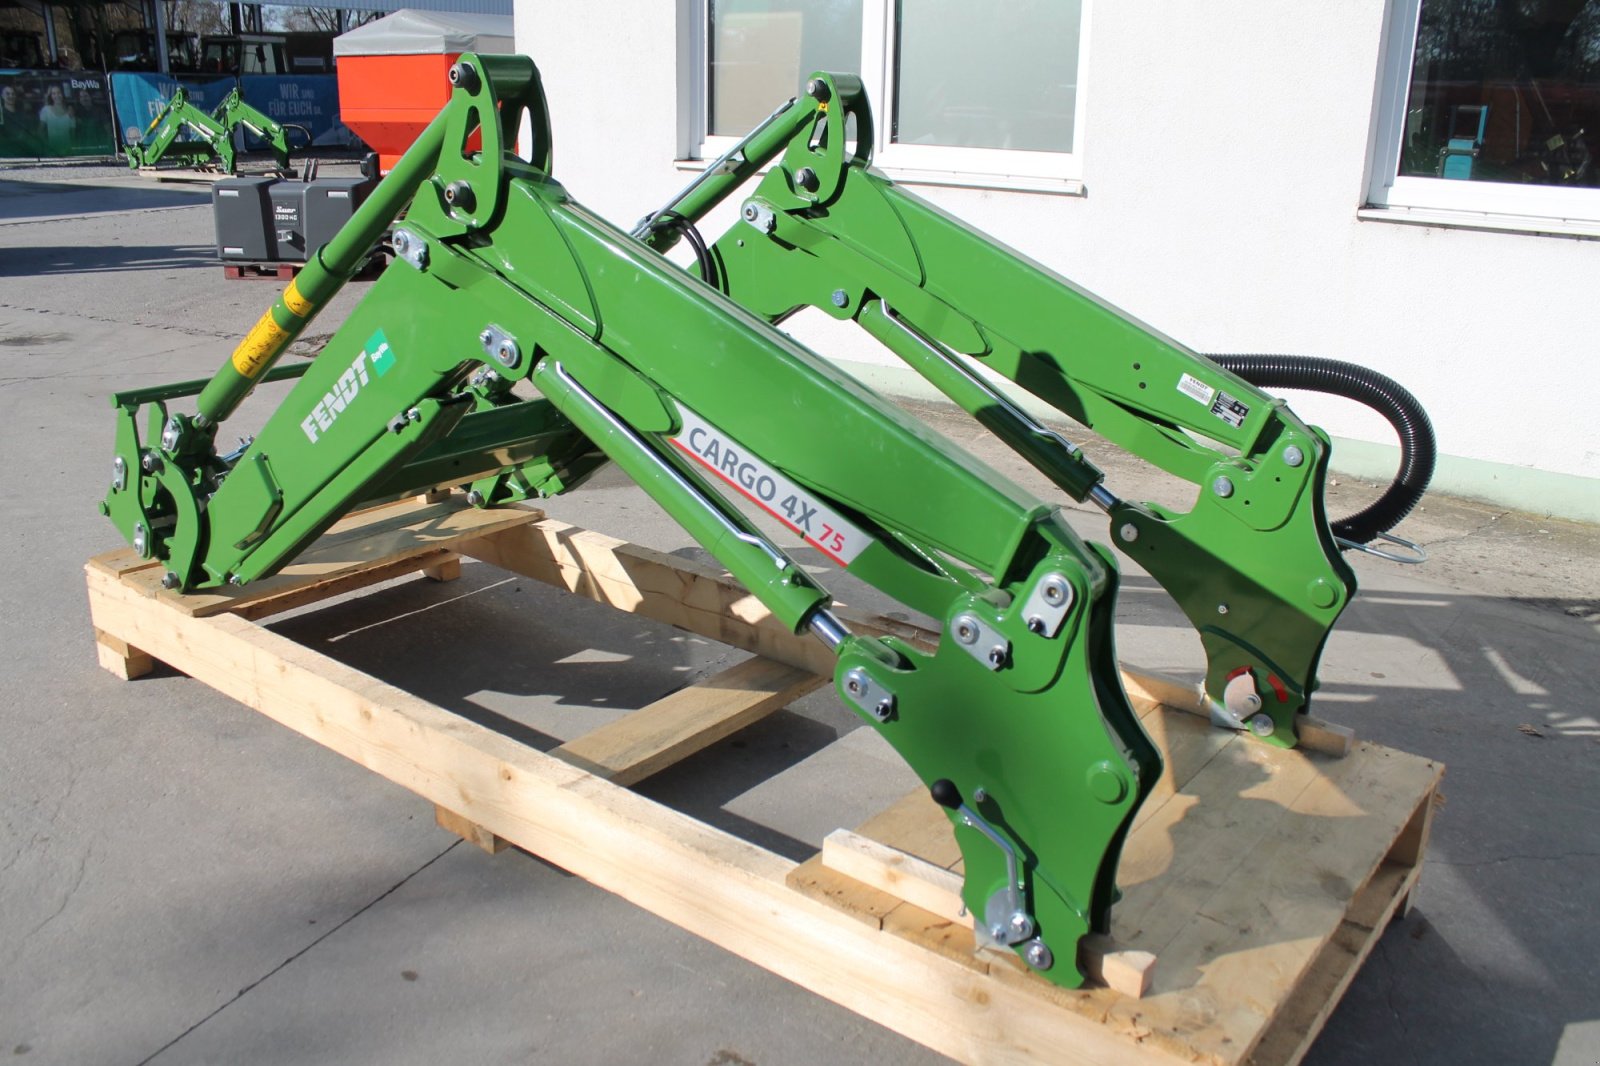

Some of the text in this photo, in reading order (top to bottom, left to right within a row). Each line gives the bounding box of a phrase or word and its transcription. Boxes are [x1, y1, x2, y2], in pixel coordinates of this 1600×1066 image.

[71, 79, 100, 89] BayWa
[280, 83, 299, 99] WIR
[268, 98, 287, 116] FÜR
[288, 100, 313, 116] EUCH
[370, 342, 389, 363] BayWa
[301, 350, 369, 444] FENDT
[689, 427, 845, 552] CARGO 4X 75
